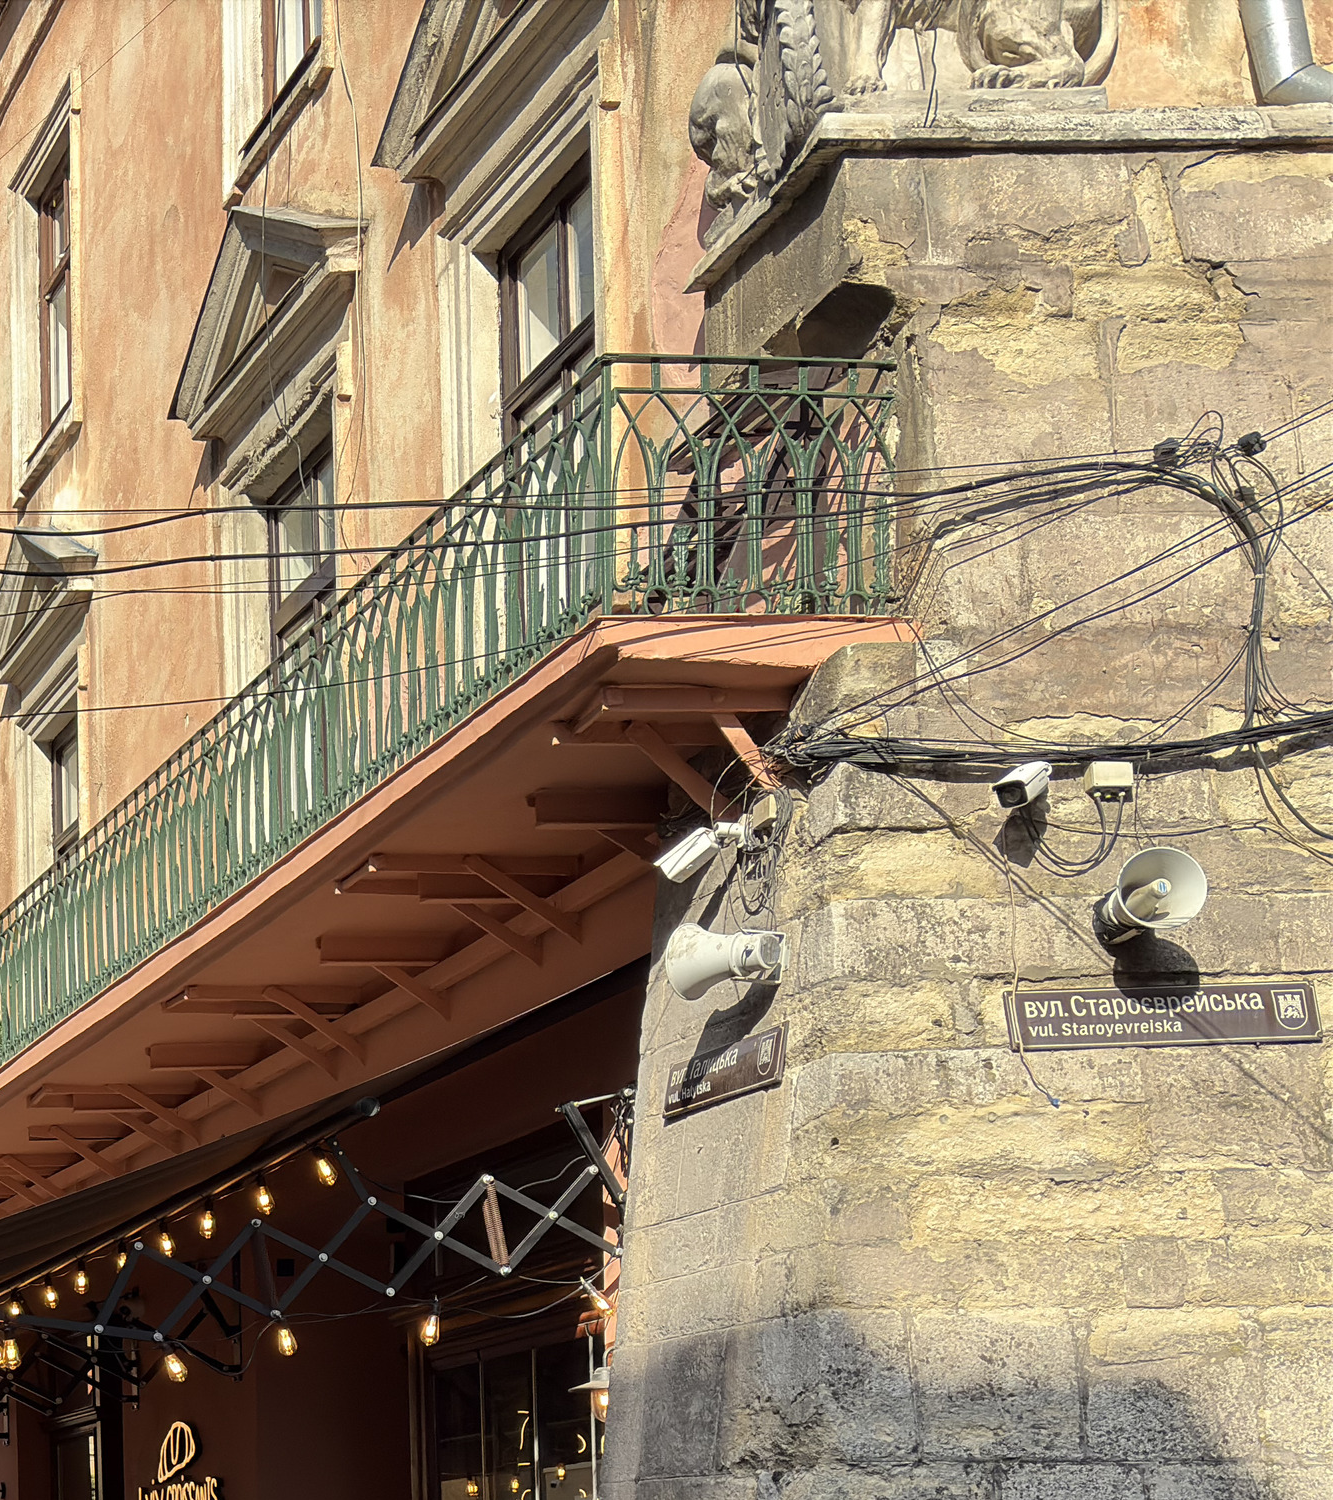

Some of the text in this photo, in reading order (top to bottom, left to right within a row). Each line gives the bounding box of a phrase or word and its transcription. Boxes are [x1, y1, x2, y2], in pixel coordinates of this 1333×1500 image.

[1024, 990, 1265, 1020] вул. Староєврейська
[1028, 1019, 1183, 1038] vul. Staroyevreiska
[689, 1048, 739, 1080] Галицька
[681, 1080, 712, 1100] Halytska
